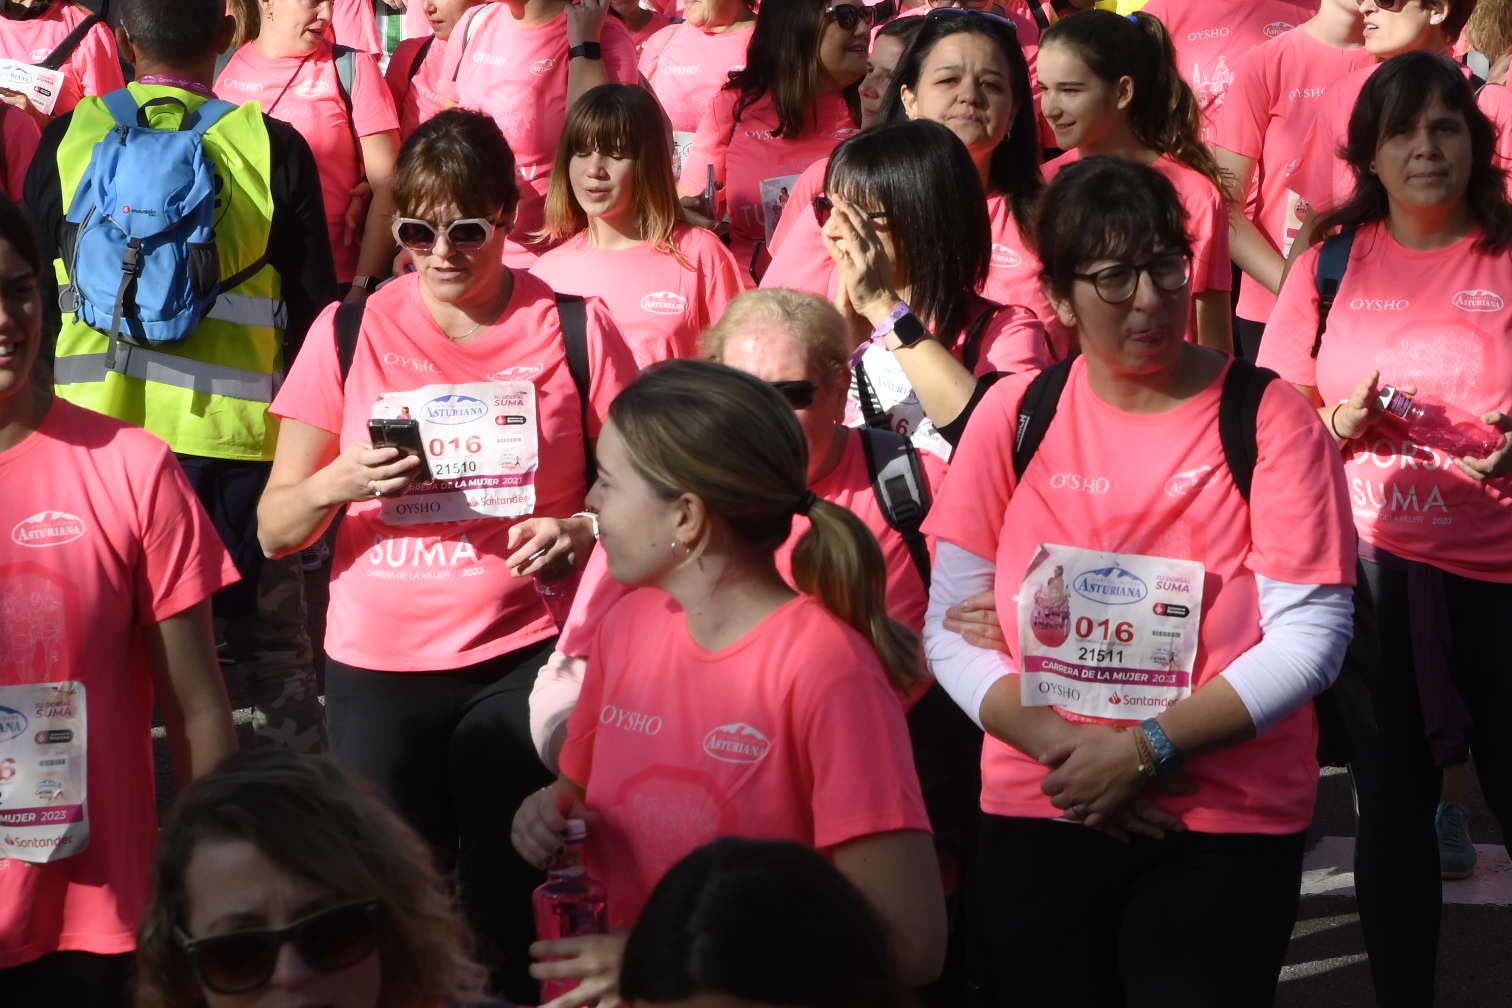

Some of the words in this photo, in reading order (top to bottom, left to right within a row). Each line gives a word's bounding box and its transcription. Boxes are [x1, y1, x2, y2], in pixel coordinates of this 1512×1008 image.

[1187, 27, 1231, 41] OYSHO
[1350, 298, 1409, 311] OYSHO
[427, 405, 484, 419] ASTURIANA
[429, 435, 482, 457] 016
[436, 461, 477, 475] 21510
[455, 480, 468, 489] LA
[469, 478, 499, 488] MUJER
[1352, 479, 1449, 513] SUMA
[396, 502, 441, 515] OYSHO
[19, 526, 81, 540] ASTURIANA
[369, 535, 478, 569] SUMA
[1078, 577, 1141, 598] ASTURIANA
[1155, 582, 1190, 593] SUMA
[1075, 616, 1134, 642] 016
[1078, 647, 1124, 663] 21511
[1042, 661, 1079, 677] CARRERA
[1081, 669, 1095, 679] DE
[1097, 671, 1109, 680] LA
[1113, 671, 1148, 681] MUJER
[1038, 680, 1081, 701] OYSHO
[601, 705, 662, 736] OYSHO
[708, 735, 765, 757] ASTURIANA
[41, 812, 67, 821] 2023
[15, 835, 73, 848] Santander
